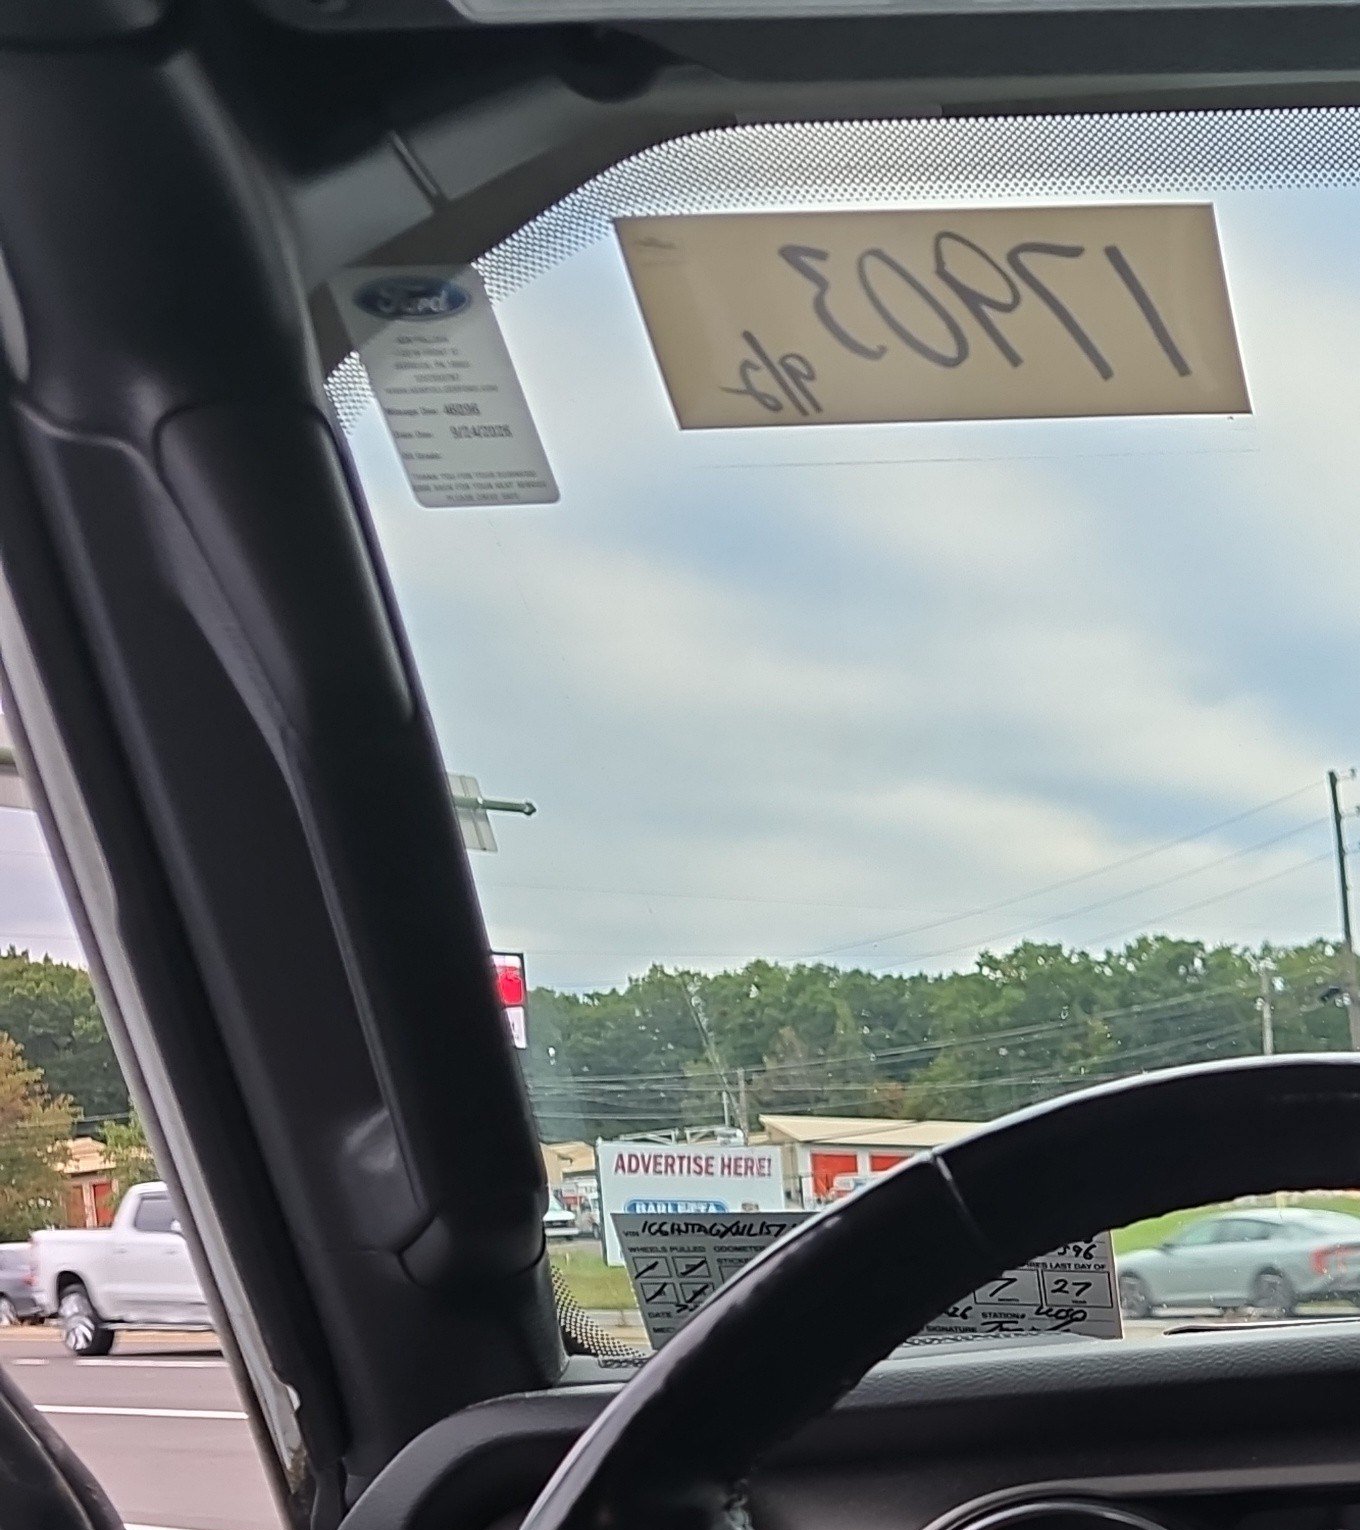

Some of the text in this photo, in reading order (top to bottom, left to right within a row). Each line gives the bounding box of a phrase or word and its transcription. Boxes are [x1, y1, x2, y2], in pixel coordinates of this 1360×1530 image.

[614, 1153, 773, 1178] ADVERTISE HERE!
[1051, 1279, 1092, 1297] 27
[926, 1325, 978, 1333] SIGNATURE
